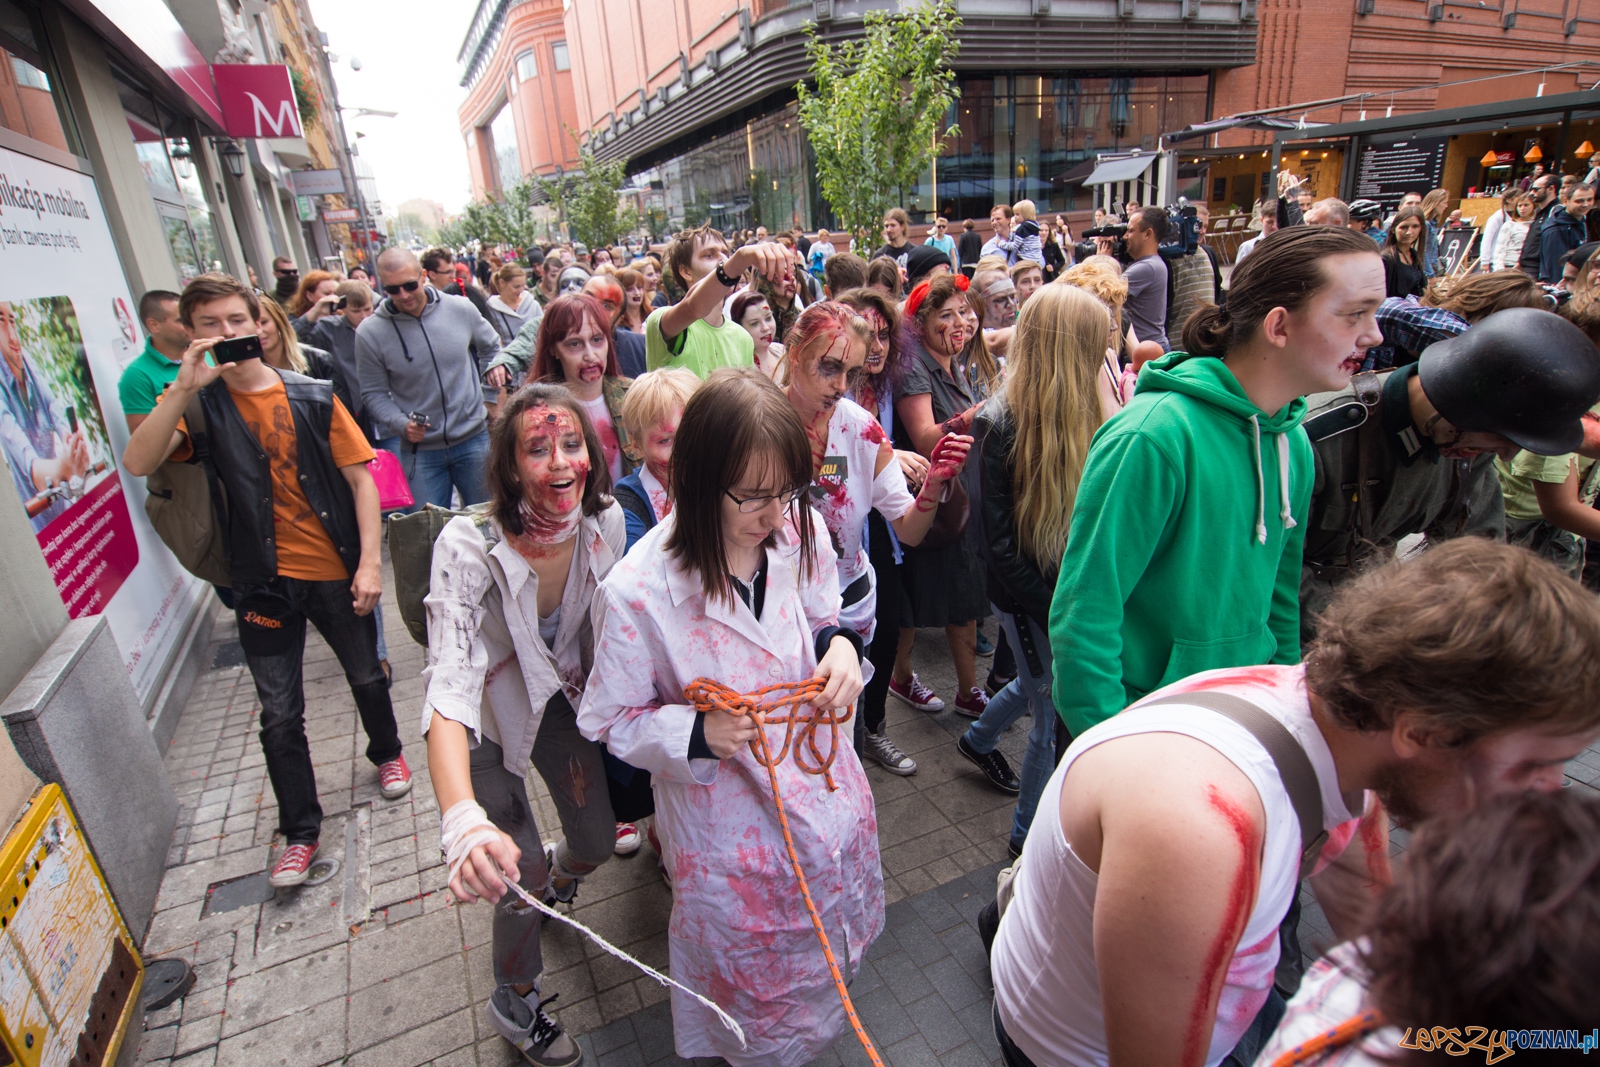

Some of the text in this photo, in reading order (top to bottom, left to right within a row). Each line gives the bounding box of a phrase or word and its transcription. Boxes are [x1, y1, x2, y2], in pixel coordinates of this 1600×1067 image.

[243, 91, 301, 137] M
[0, 173, 90, 221] likacja mobilna
[23, 230, 52, 248] zawsze
[819, 464, 837, 475] KUJ
[244, 611, 284, 629] PATROL
